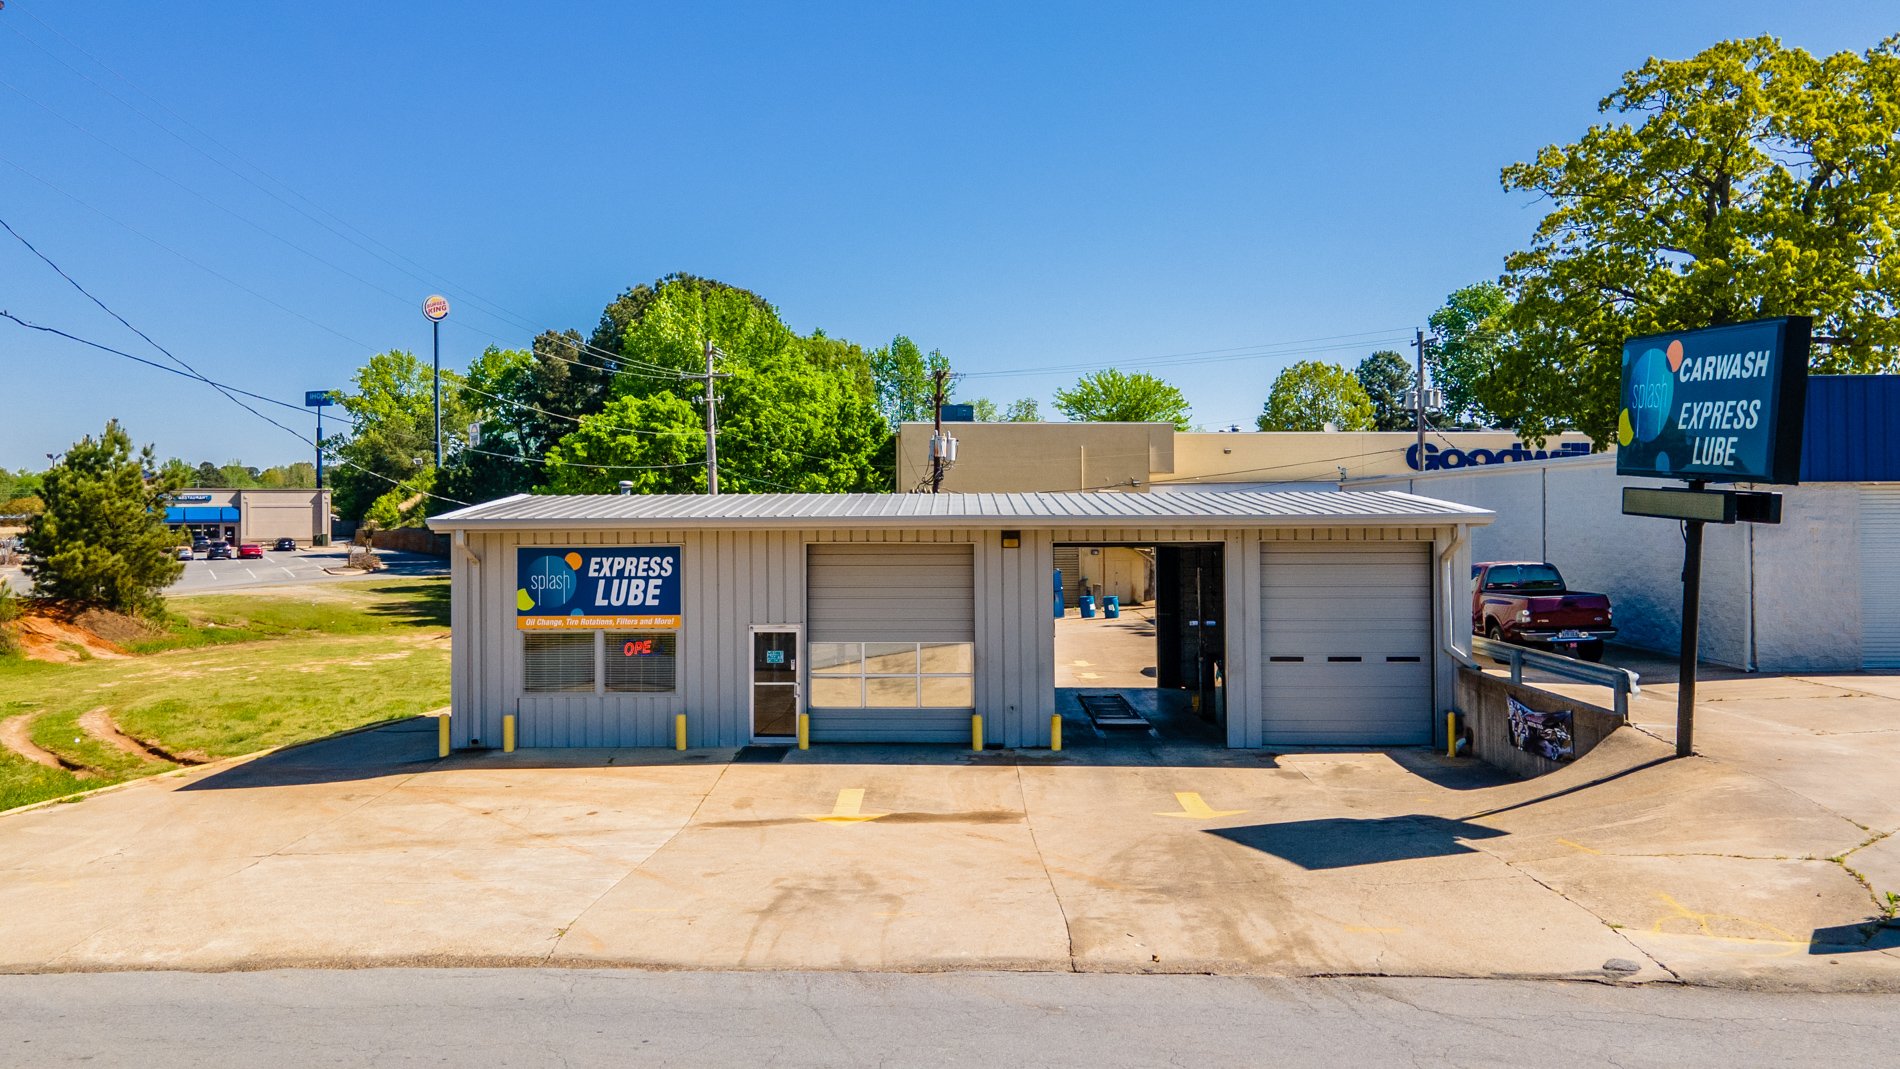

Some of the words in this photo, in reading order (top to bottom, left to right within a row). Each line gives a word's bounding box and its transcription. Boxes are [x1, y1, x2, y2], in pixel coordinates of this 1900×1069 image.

[427, 301, 446, 309] BURGER
[427, 305, 447, 314] KING
[1679, 350, 1770, 383] CARWASH
[1632, 350, 1668, 438] splash
[1677, 399, 1761, 430] EXPRESS
[1692, 436, 1738, 466] LUBE
[588, 556, 673, 577] EXPRESS
[530, 555, 570, 607] splash
[595, 579, 662, 606] LUBE
[525, 618, 535, 627] Oil
[536, 618, 564, 627] Change,
[566, 618, 579, 626] Tire
[616, 617, 639, 626] Filters
[640, 617, 653, 625] and
[654, 617, 675, 625] More!
